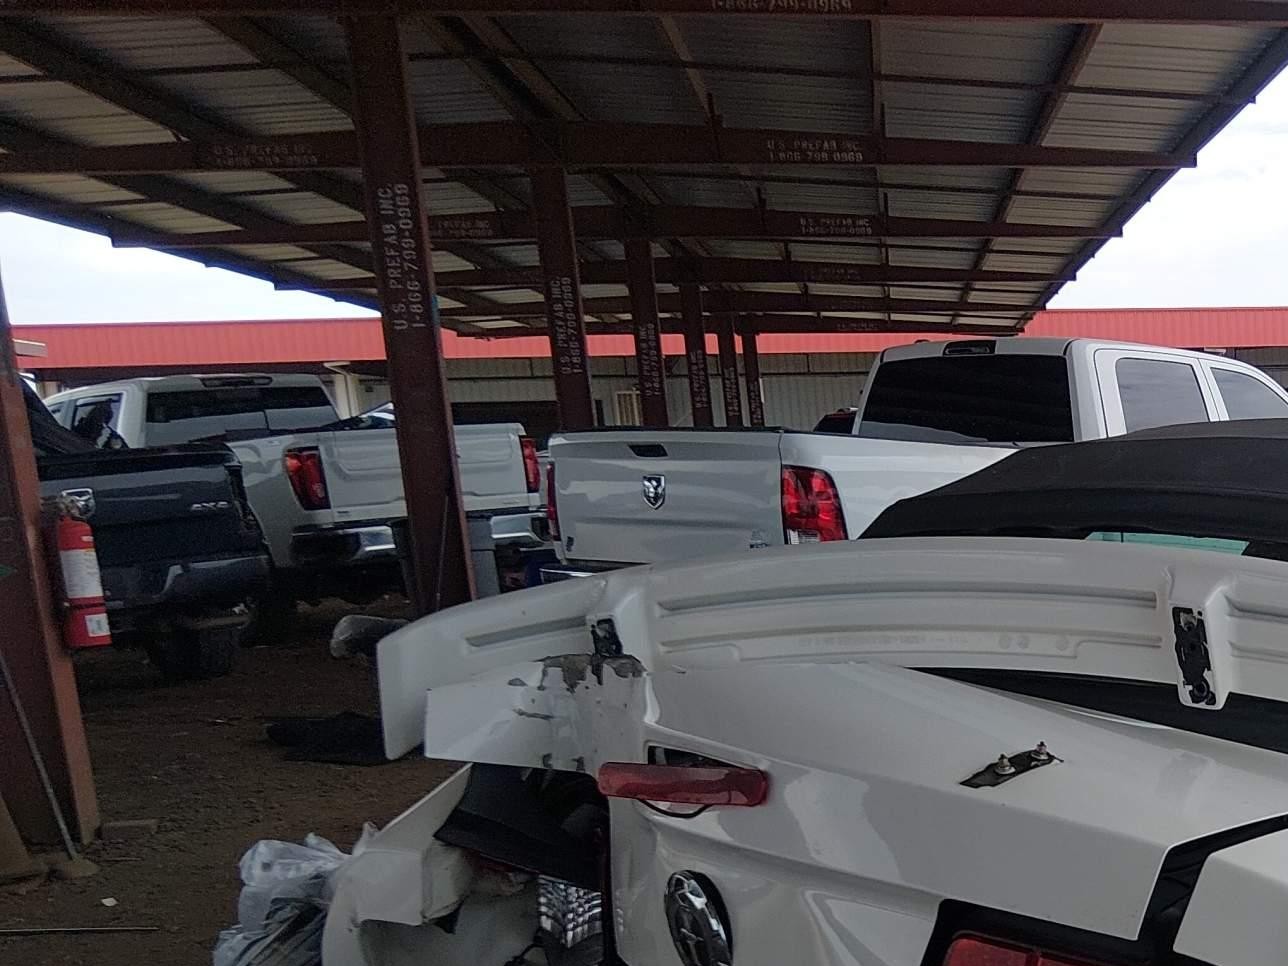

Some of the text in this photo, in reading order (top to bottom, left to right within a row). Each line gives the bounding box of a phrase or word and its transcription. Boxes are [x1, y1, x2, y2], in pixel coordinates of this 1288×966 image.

[377, 183, 409, 330] U.S. PREFAB INC.
[394, 183, 427, 328] 1-866-799-0969
